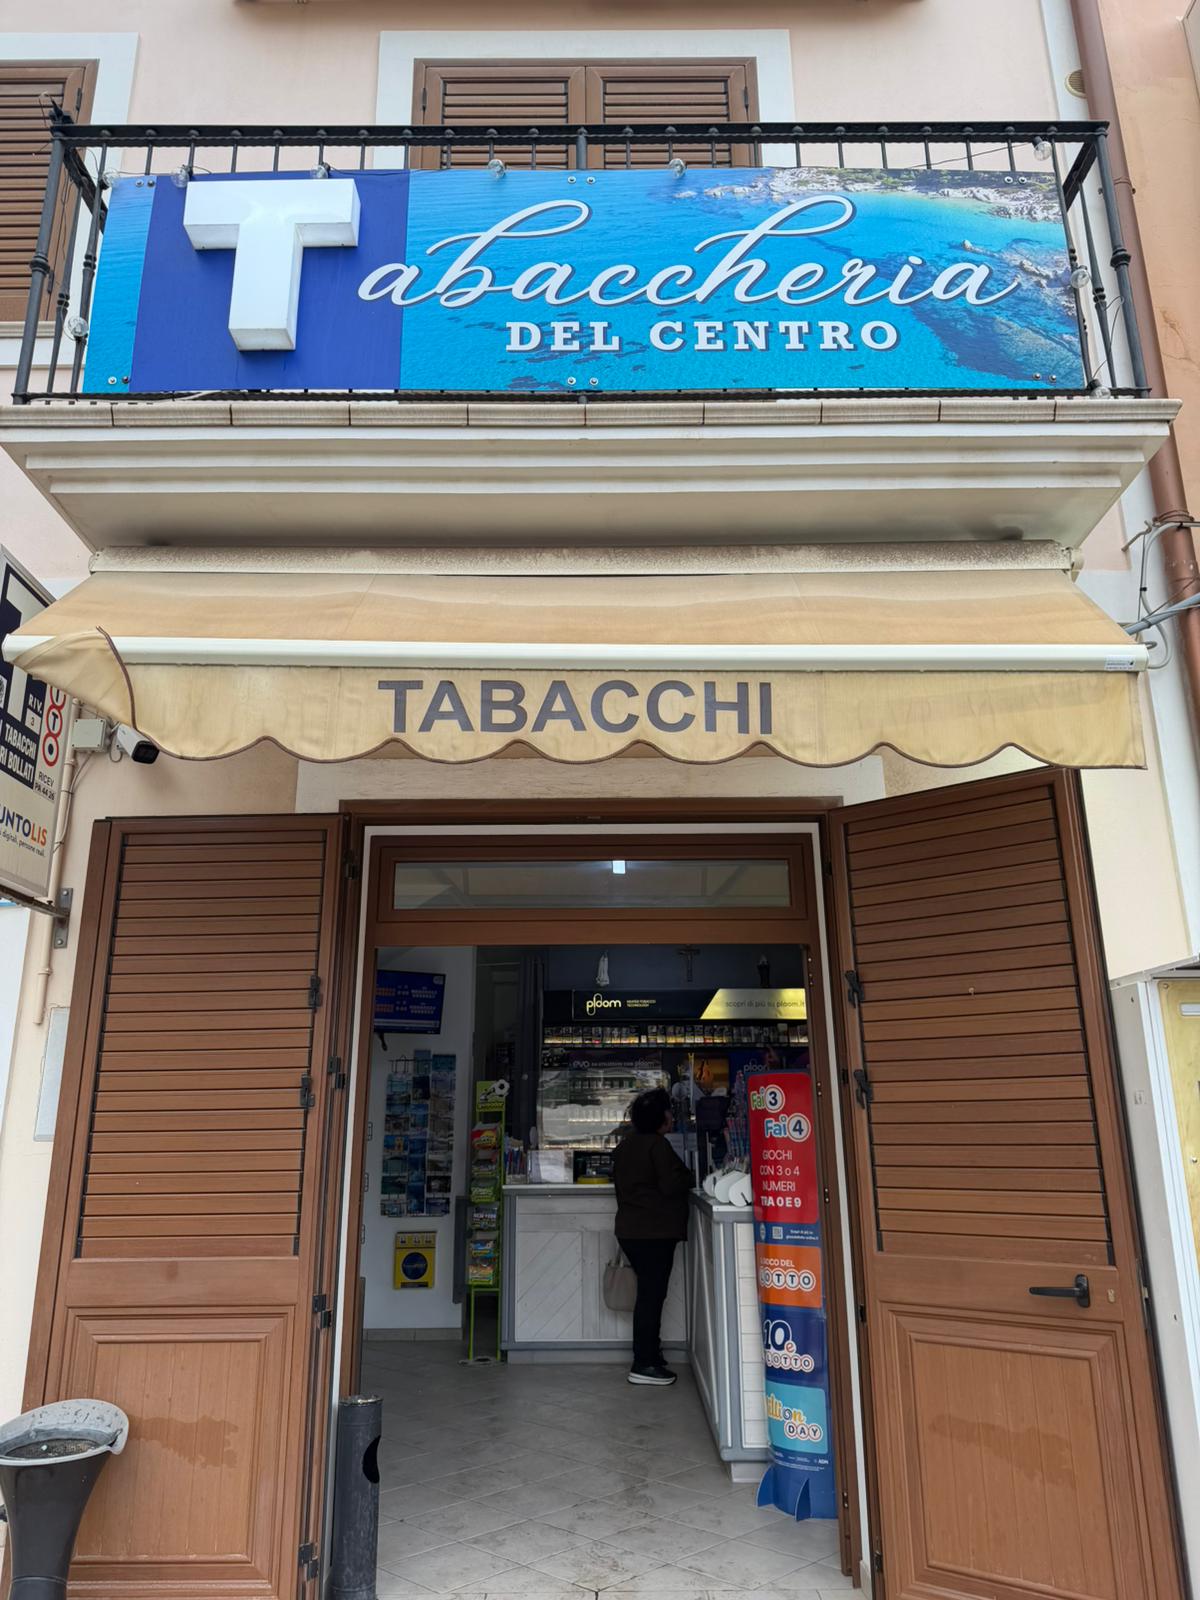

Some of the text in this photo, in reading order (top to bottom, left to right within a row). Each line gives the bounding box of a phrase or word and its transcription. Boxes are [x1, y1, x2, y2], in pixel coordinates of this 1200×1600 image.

[506, 320, 900, 353] DEL CENTRO
[28, 693, 43, 714] RIV.
[378, 680, 772, 735] TABACCHI
[5, 723, 37, 760] TABACCHI
[8, 751, 35, 784] BOLLATI
[586, 993, 622, 1016] ploom
[765, 1115, 788, 1137] Fai
[777, 1165, 783, 1176] 3
[793, 1166, 800, 1176] 4
[785, 1197, 793, 1208] E
[794, 1197, 802, 1208] 9
[780, 1259, 795, 1267] DEL
[786, 1423, 820, 1439] DAY
